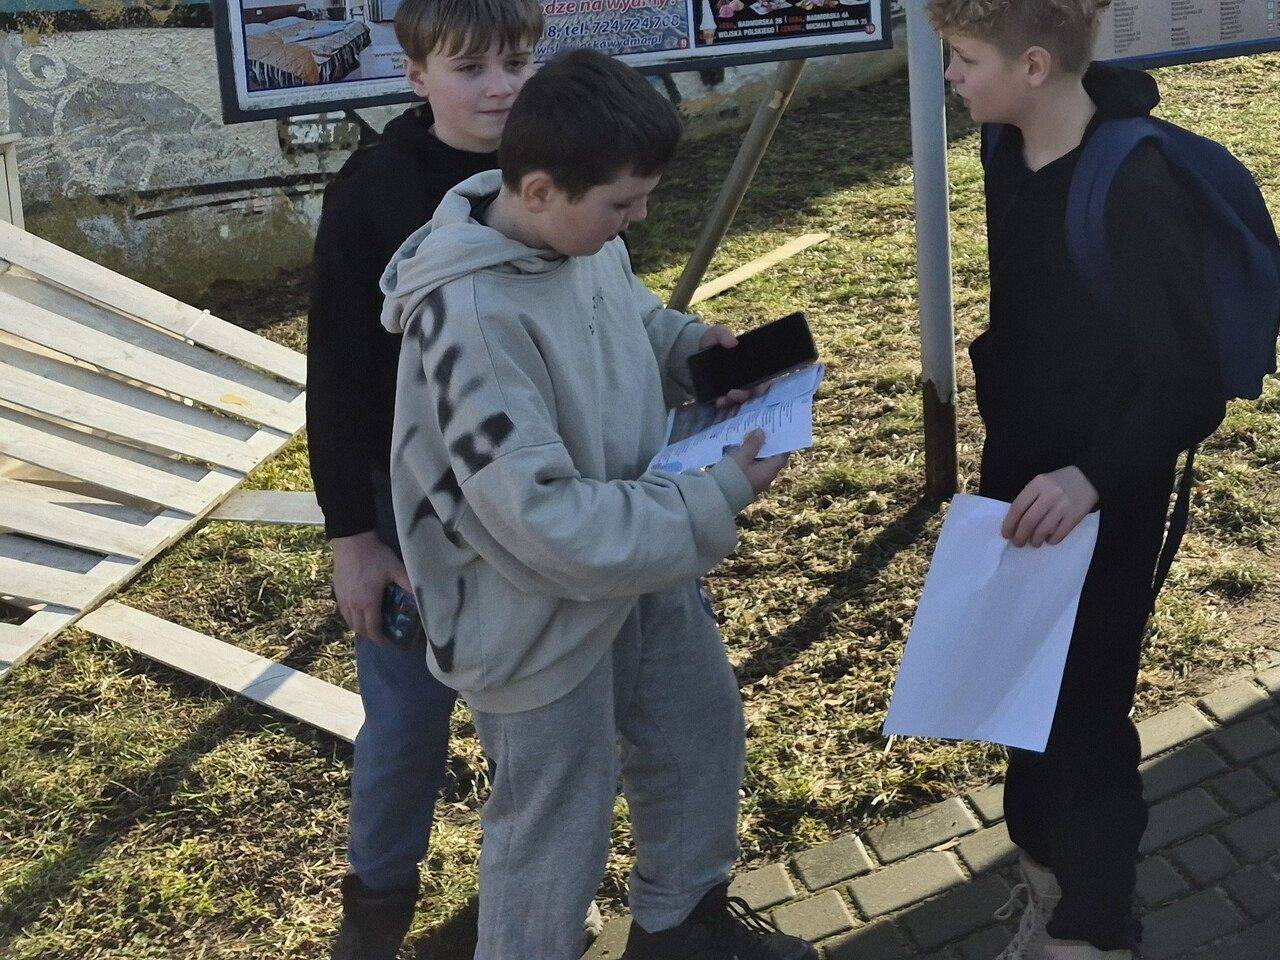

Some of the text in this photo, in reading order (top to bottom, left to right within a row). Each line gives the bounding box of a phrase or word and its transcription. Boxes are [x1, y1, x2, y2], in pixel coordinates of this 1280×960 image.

[580, 0, 603, 12] na
[565, 18, 650, 36] tel. 724 724
